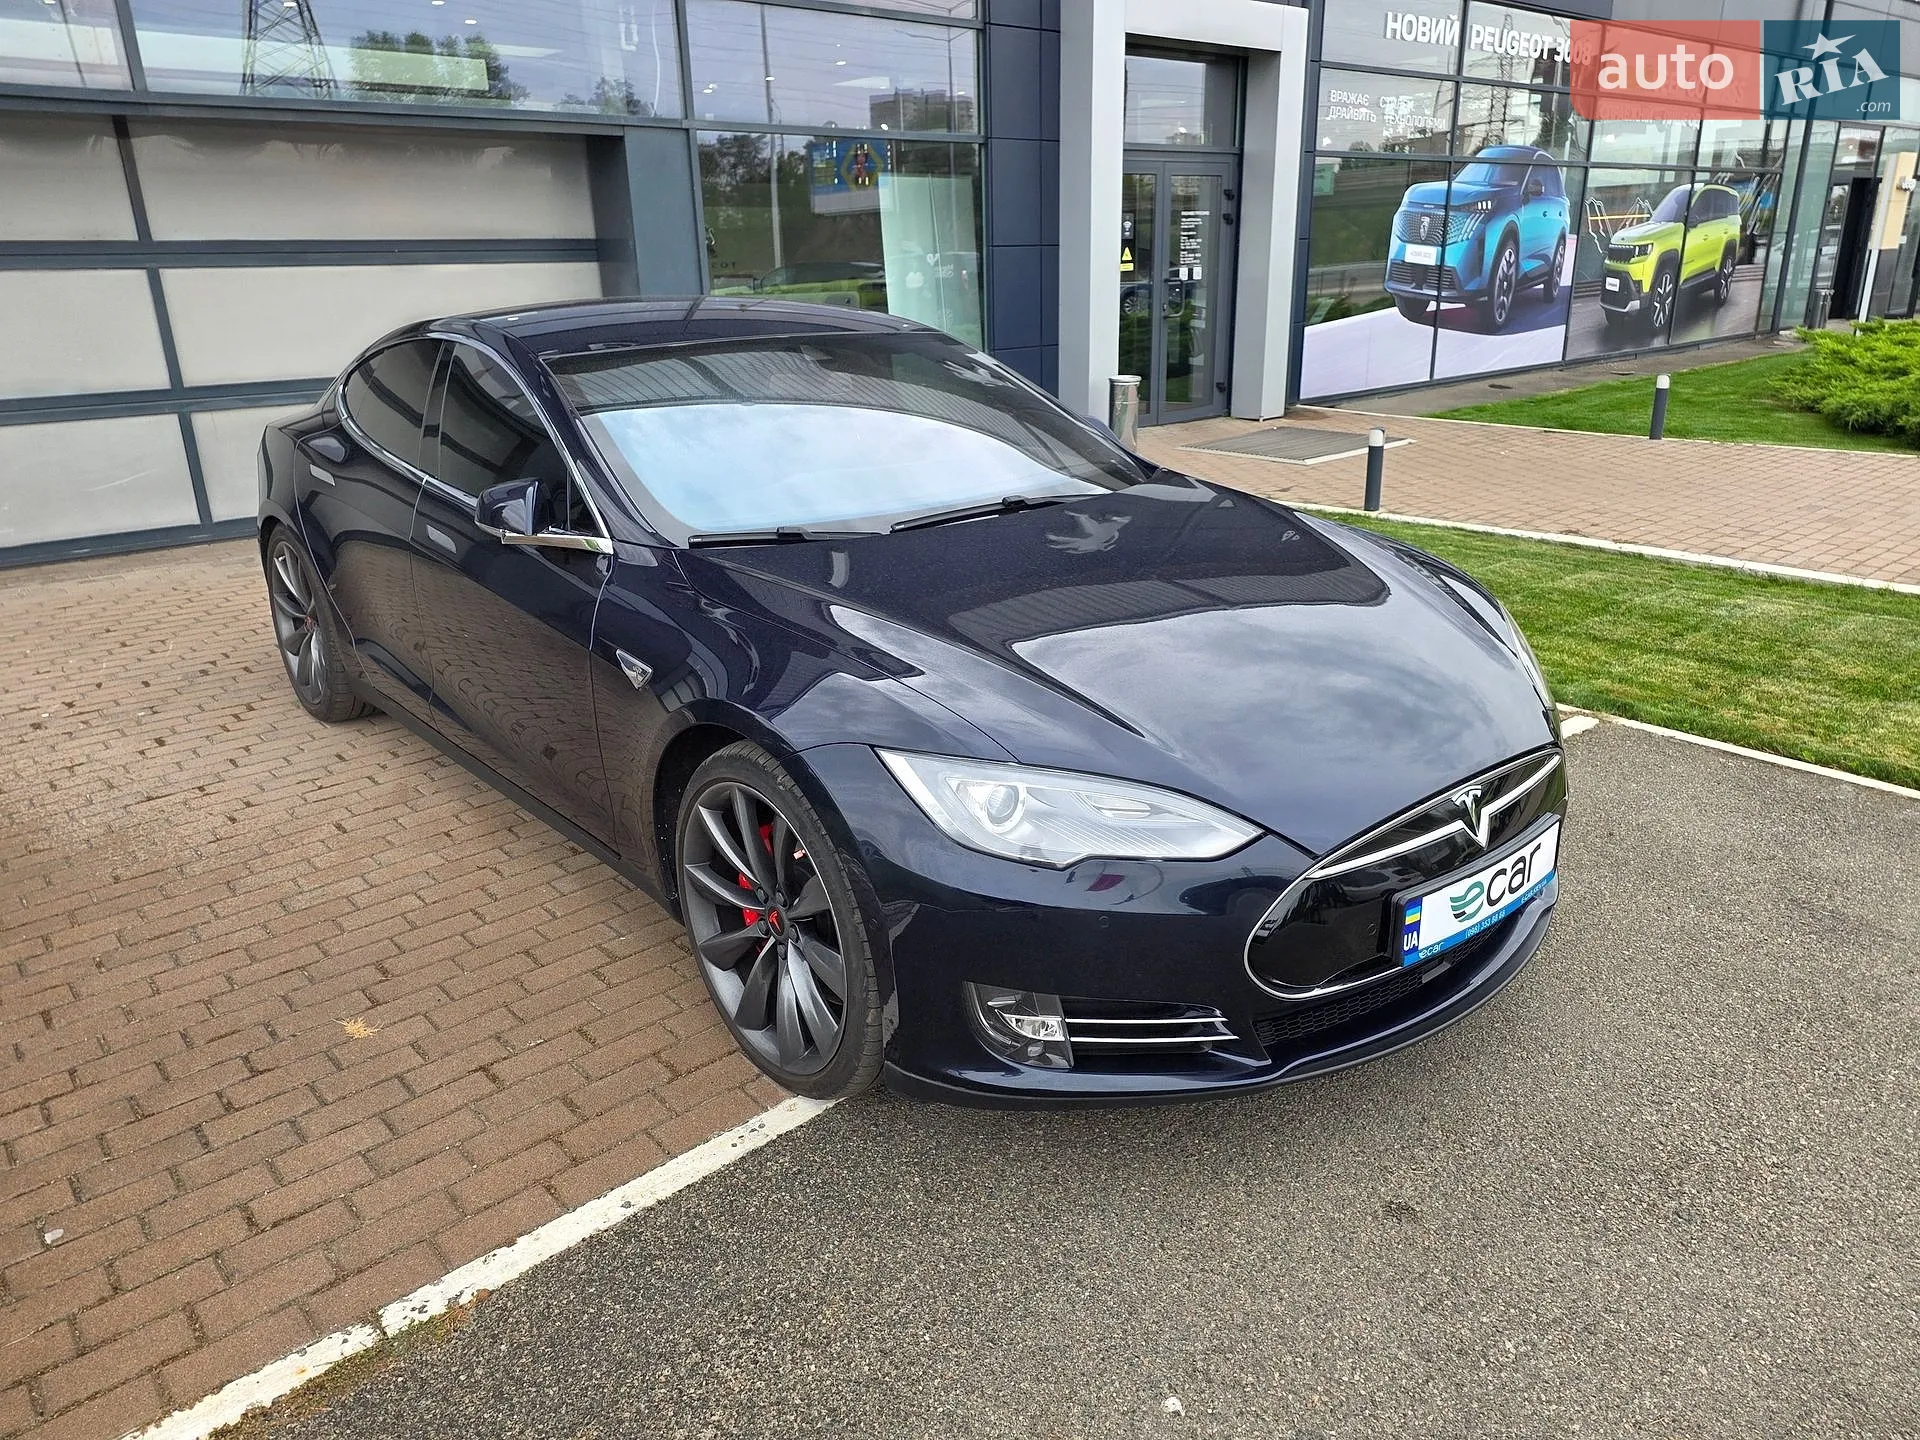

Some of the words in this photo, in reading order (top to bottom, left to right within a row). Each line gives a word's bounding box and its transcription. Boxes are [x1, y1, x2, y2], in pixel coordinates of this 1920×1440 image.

[1385, 11, 1460, 48] НОВИЙ
[1470, 24, 1553, 60] PEUGEOT
[1330, 89, 1370, 106] ВРАЖАЄ
[1328, 105, 1377, 123] ДРАЙВИТЬ
[1449, 842, 1542, 923] ecar
[1403, 931, 1419, 951] UA
[1419, 941, 1444, 959] ecar
